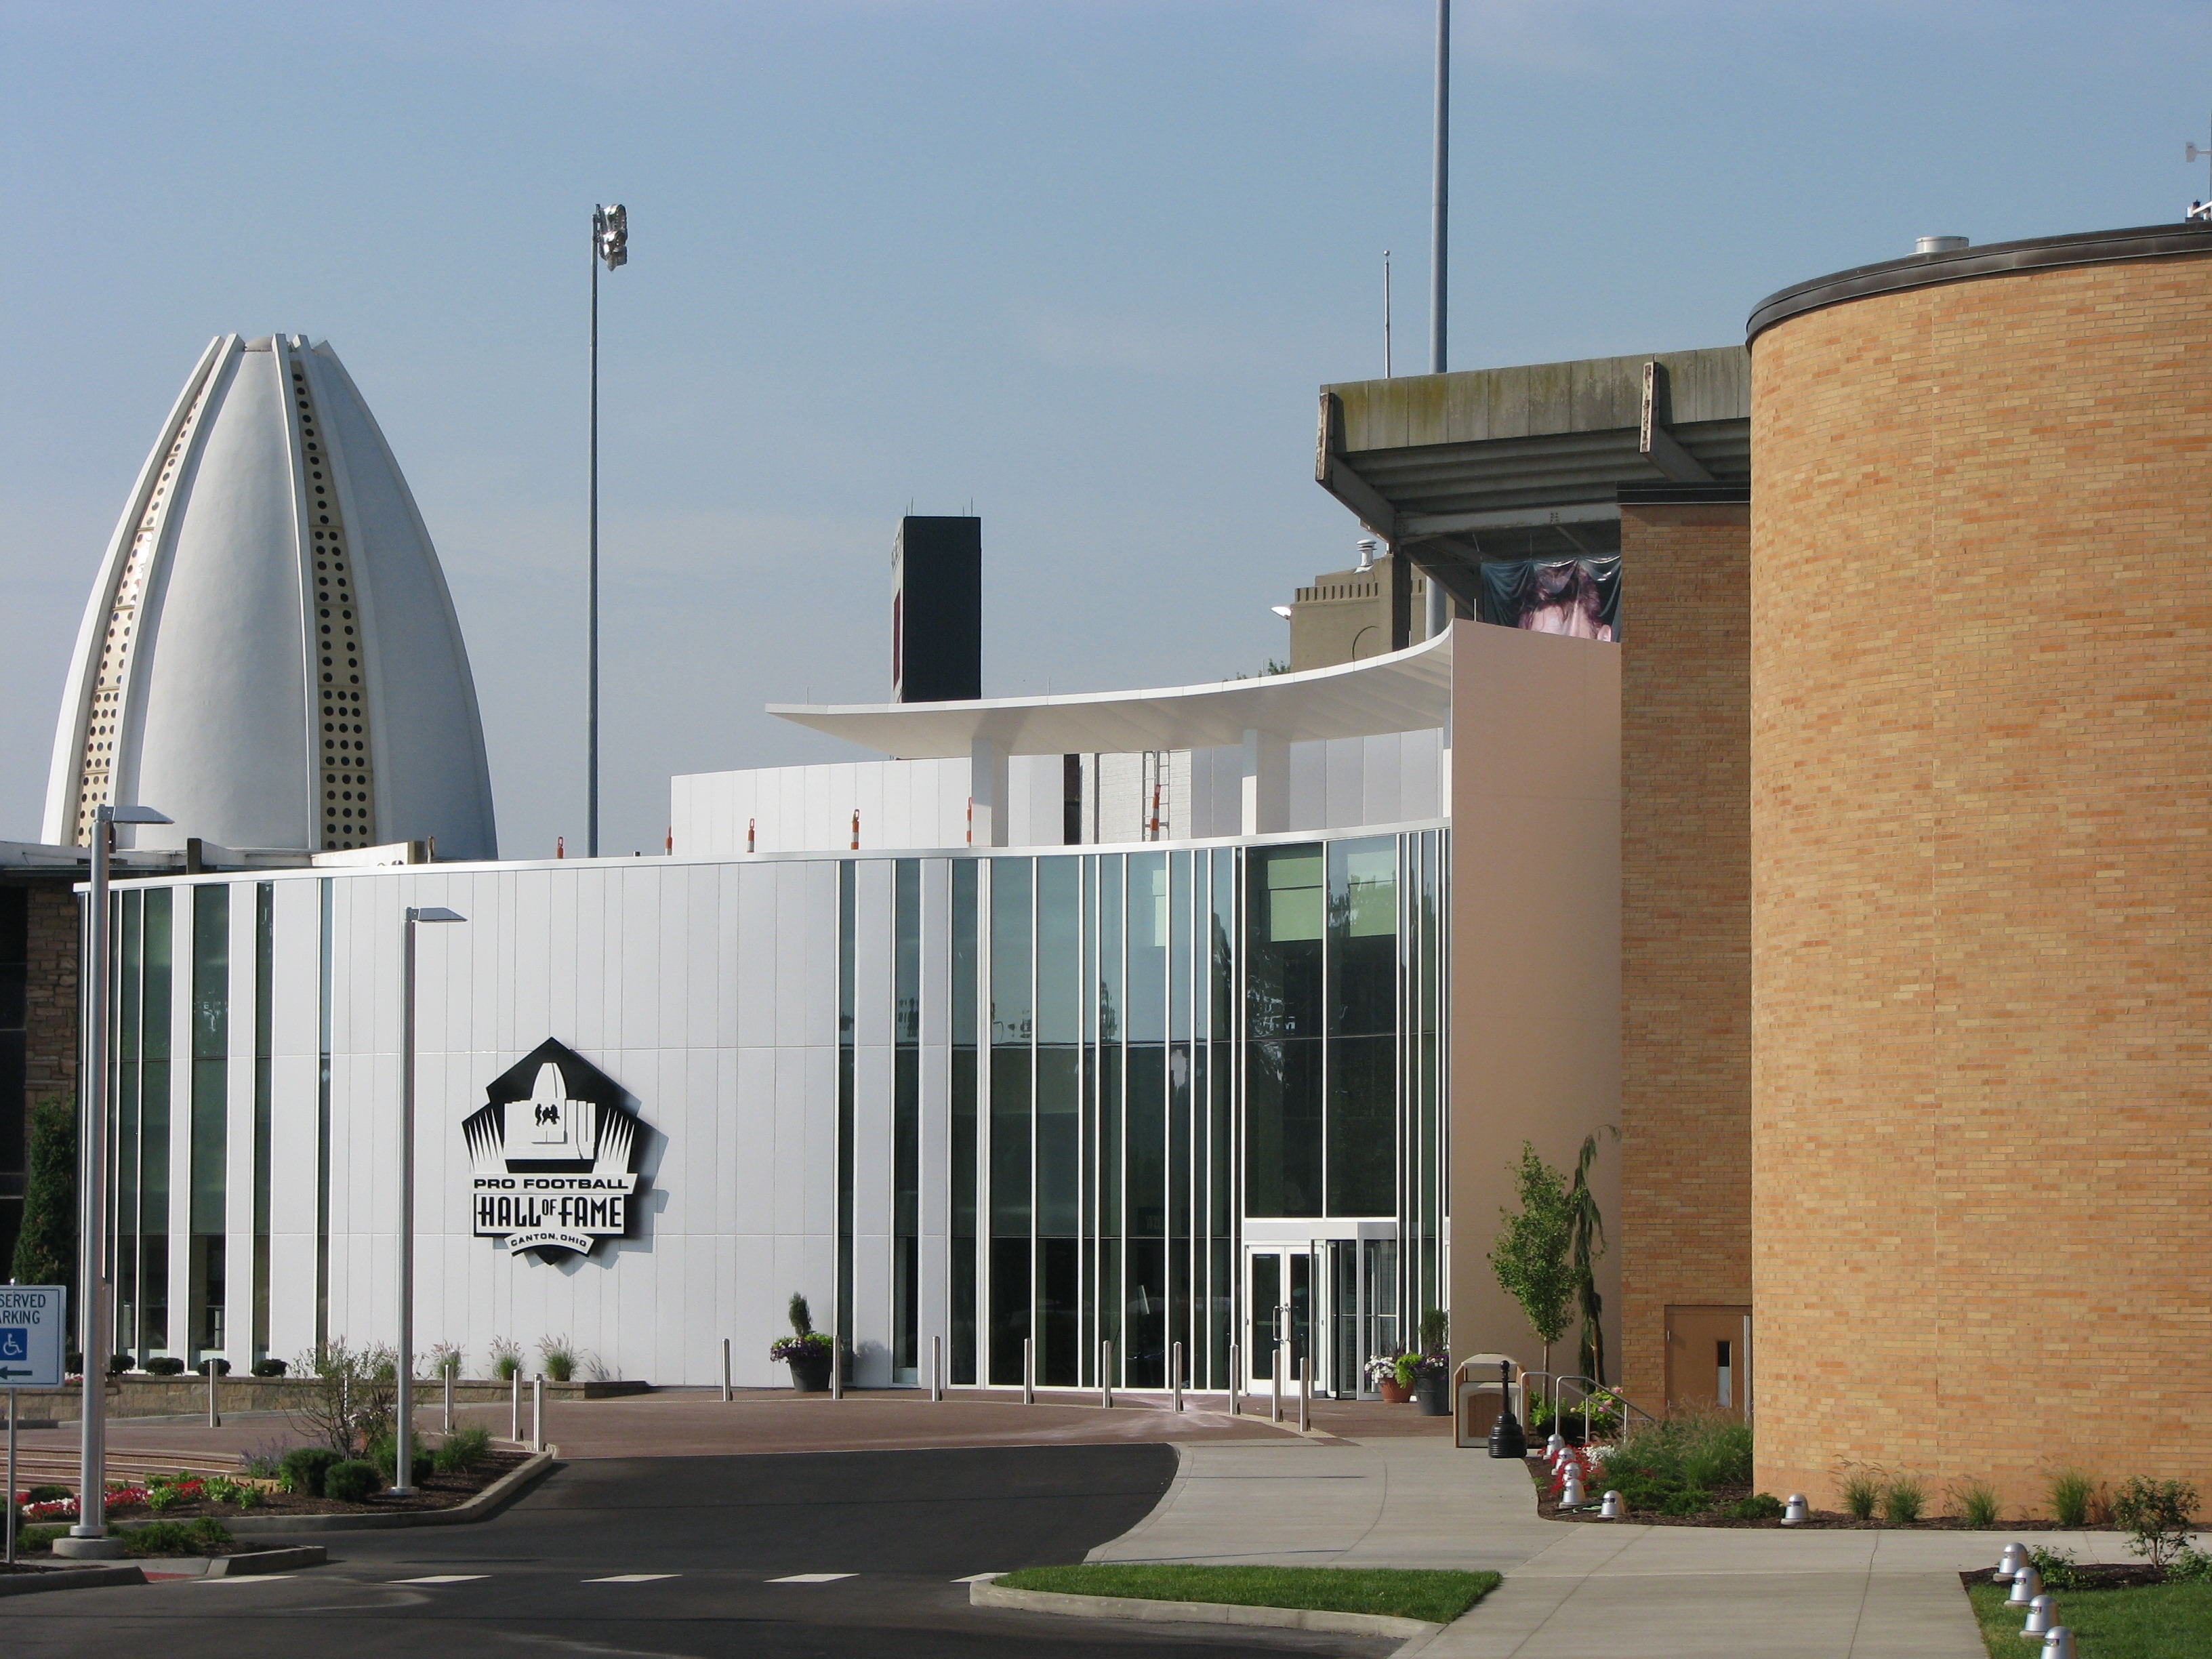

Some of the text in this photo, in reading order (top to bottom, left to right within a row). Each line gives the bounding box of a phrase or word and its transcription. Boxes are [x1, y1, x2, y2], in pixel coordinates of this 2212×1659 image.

[474, 1179, 629, 1189] PRO FOOTBALL
[478, 1196, 622, 1227] HALL OF FAME
[560, 1233, 587, 1248] OHIO
[0, 1310, 40, 1324] RKING
